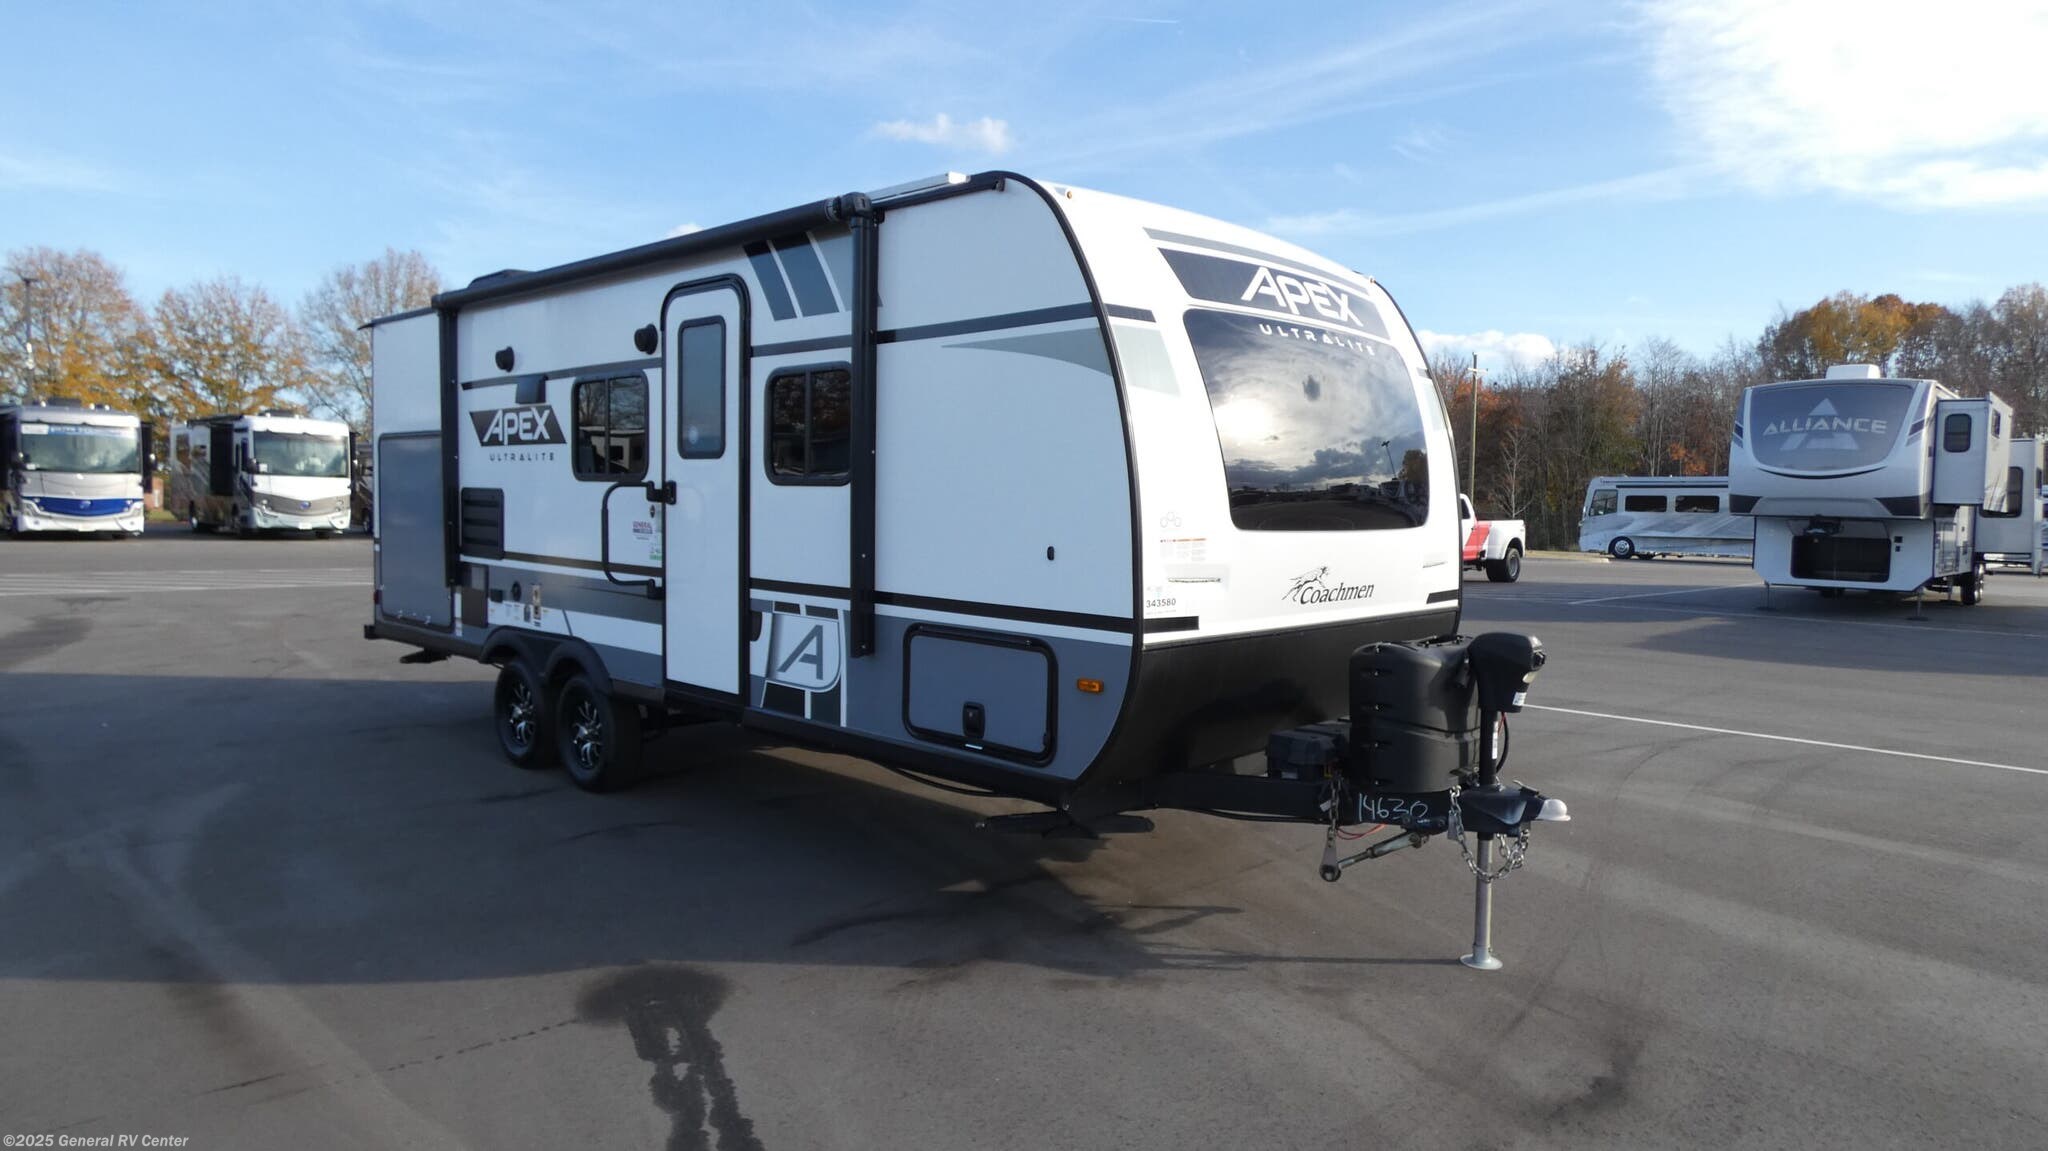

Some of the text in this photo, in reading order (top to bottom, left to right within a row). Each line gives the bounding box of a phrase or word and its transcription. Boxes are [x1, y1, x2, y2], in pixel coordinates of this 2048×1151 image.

[1240, 266, 1364, 327] APEX
[1258, 323, 1375, 356] ULTRALITE
[482, 406, 551, 446] APEX
[1762, 416, 1888, 436] ALLIANCE
[489, 452, 556, 462] ULTRALITE
[1145, 598, 1177, 609] 343580
[1300, 582, 1375, 605] Coachmen
